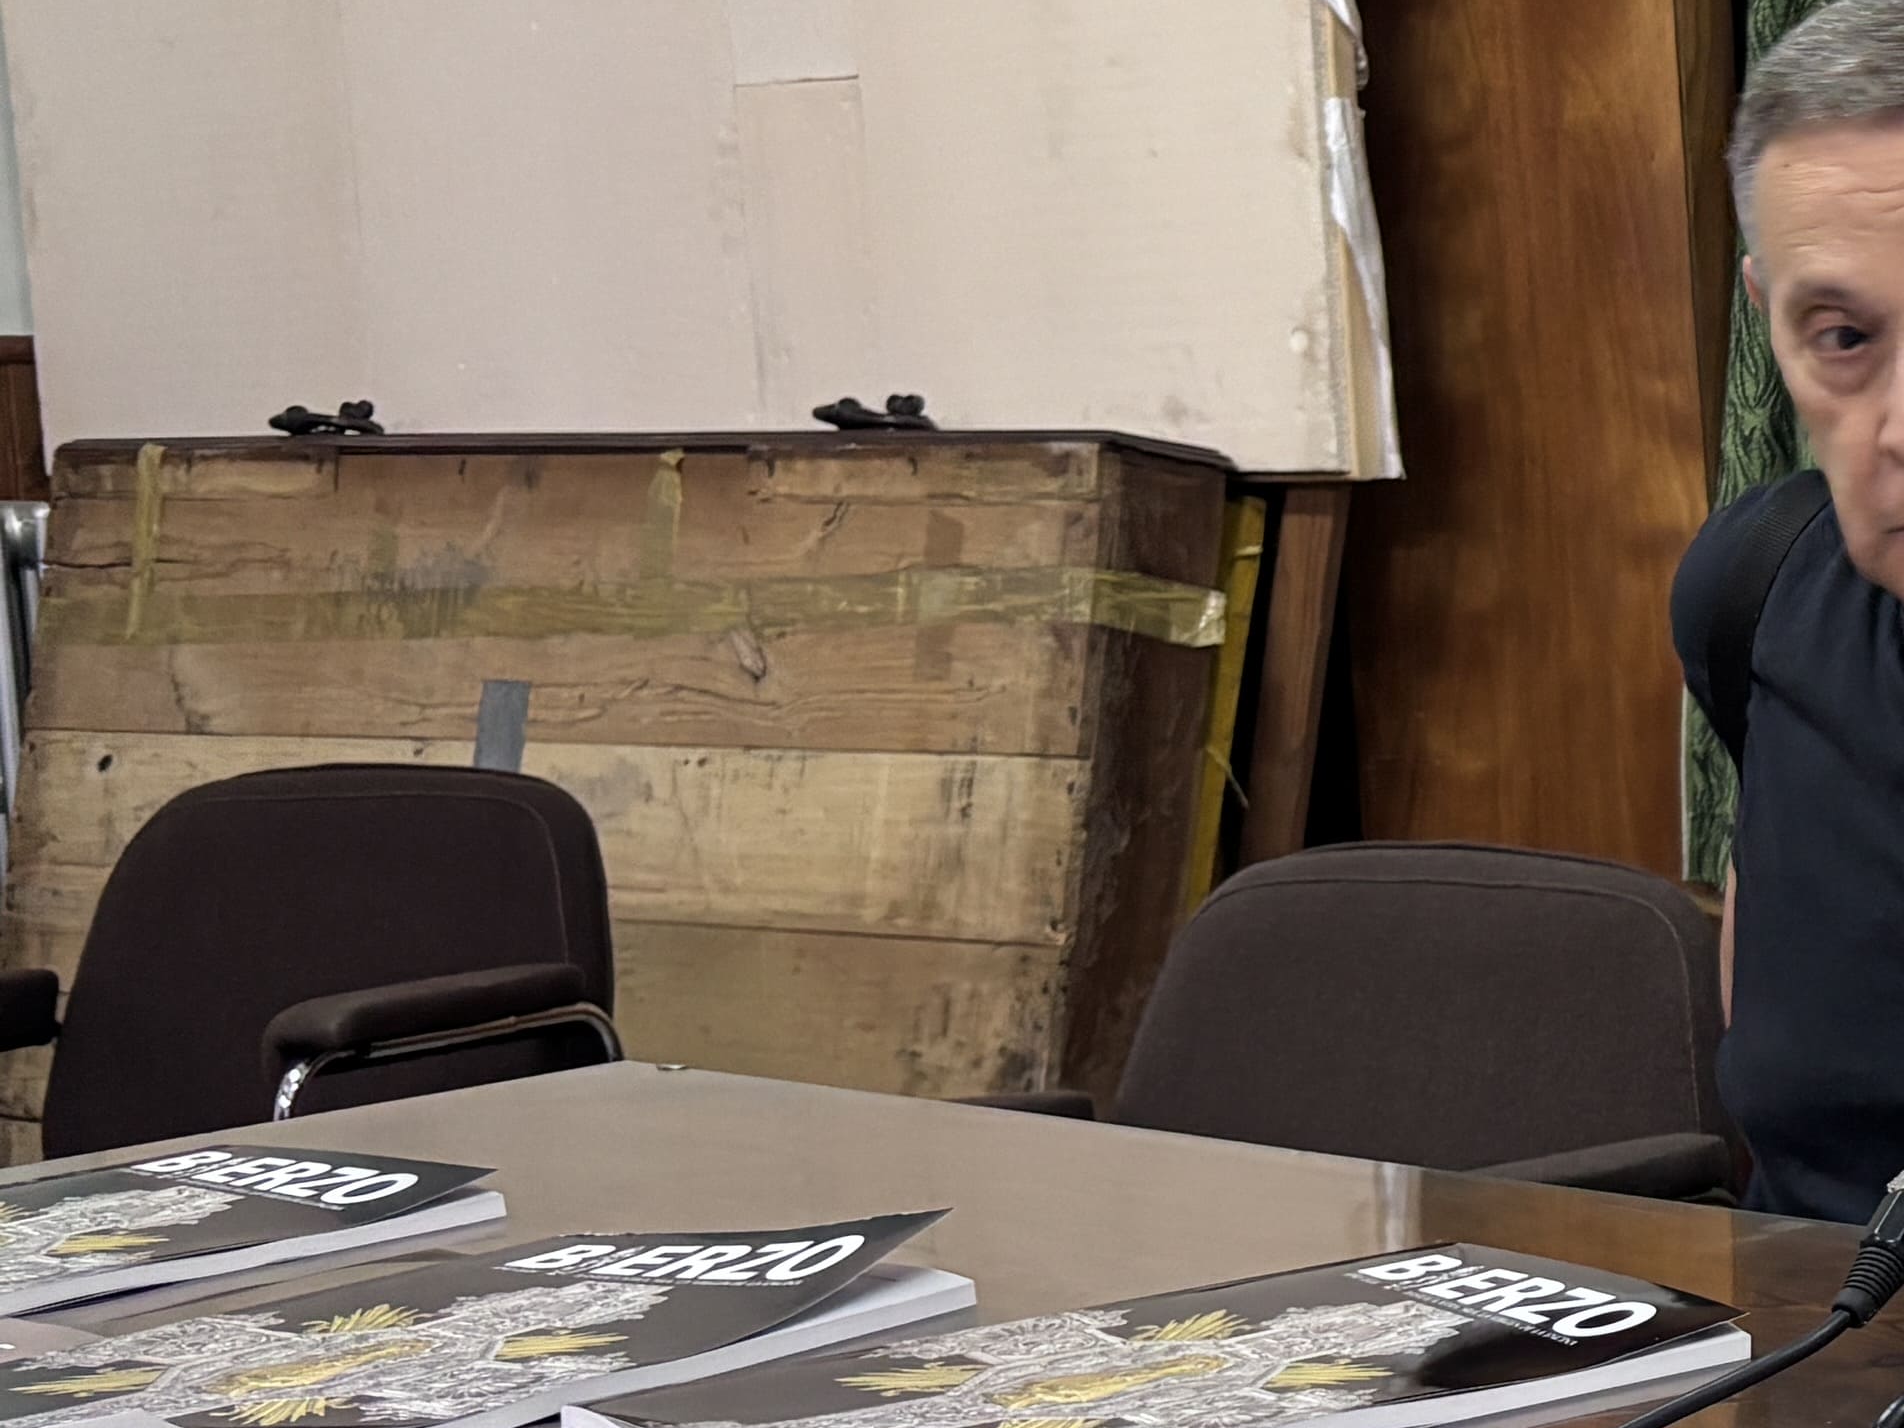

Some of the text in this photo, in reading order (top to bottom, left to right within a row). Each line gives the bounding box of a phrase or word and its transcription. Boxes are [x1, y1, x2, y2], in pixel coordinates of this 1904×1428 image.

[129, 1150, 419, 1205] BIERZO
[504, 1235, 865, 1282] BIERZO
[1358, 1253, 1658, 1338] BIERZO
